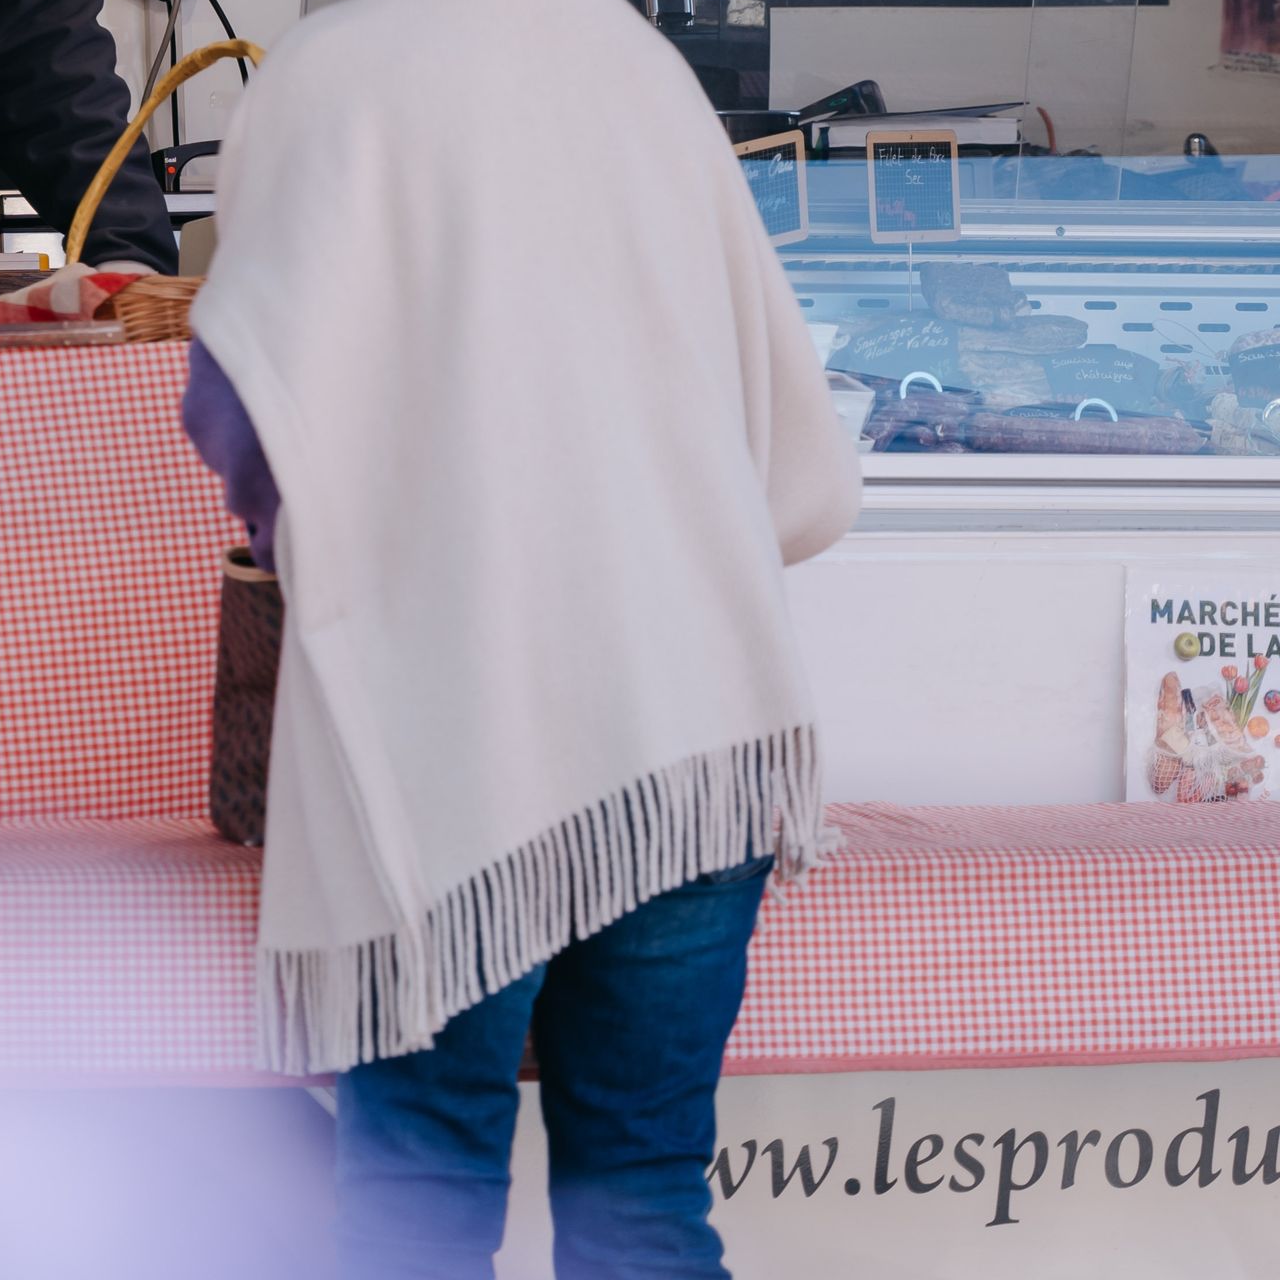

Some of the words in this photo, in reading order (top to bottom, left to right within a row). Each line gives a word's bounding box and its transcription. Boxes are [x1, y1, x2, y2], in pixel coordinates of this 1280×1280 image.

[879, 147, 903, 167] Filet
[905, 169, 925, 185] Sec
[1150, 593, 1280, 628] MARCHÉ
[1197, 631, 1237, 658] DE
[1246, 633, 1280, 659] LA
